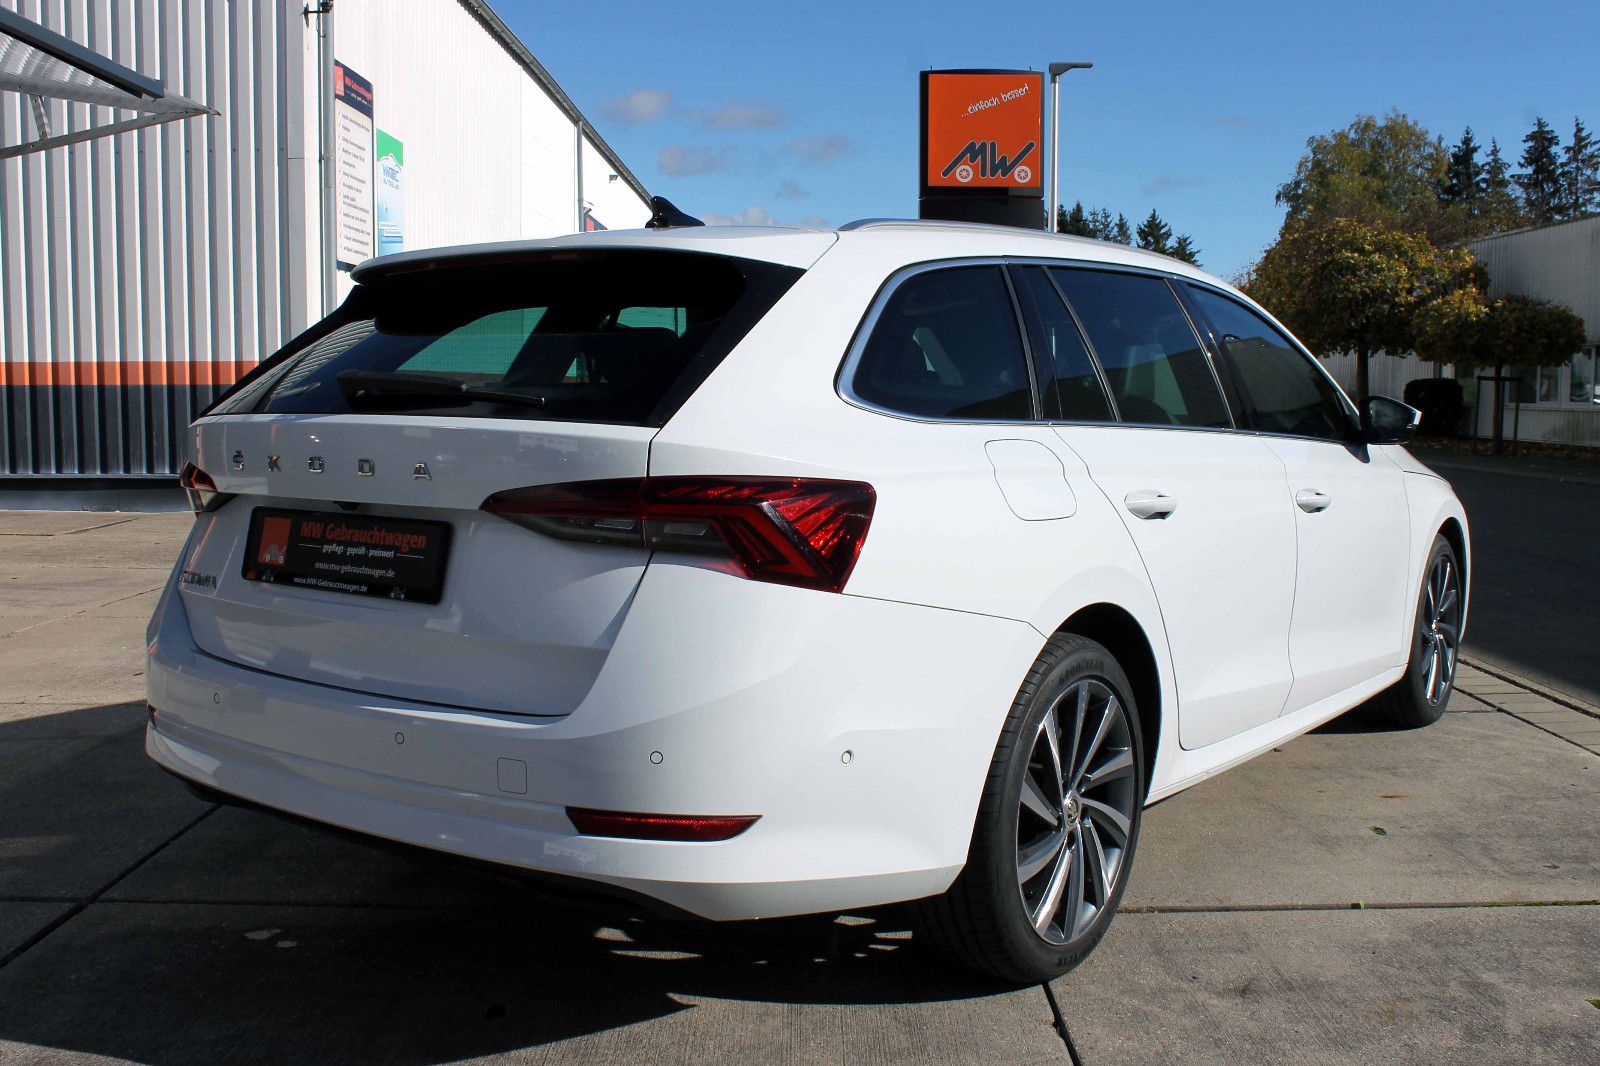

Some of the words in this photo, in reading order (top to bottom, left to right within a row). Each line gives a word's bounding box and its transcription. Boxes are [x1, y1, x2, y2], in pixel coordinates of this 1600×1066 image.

[941, 140, 1036, 179] MW
[232, 450, 432, 480] ŠKODA
[300, 521, 324, 539] MW
[325, 523, 427, 552] Gebrauchtwagen
